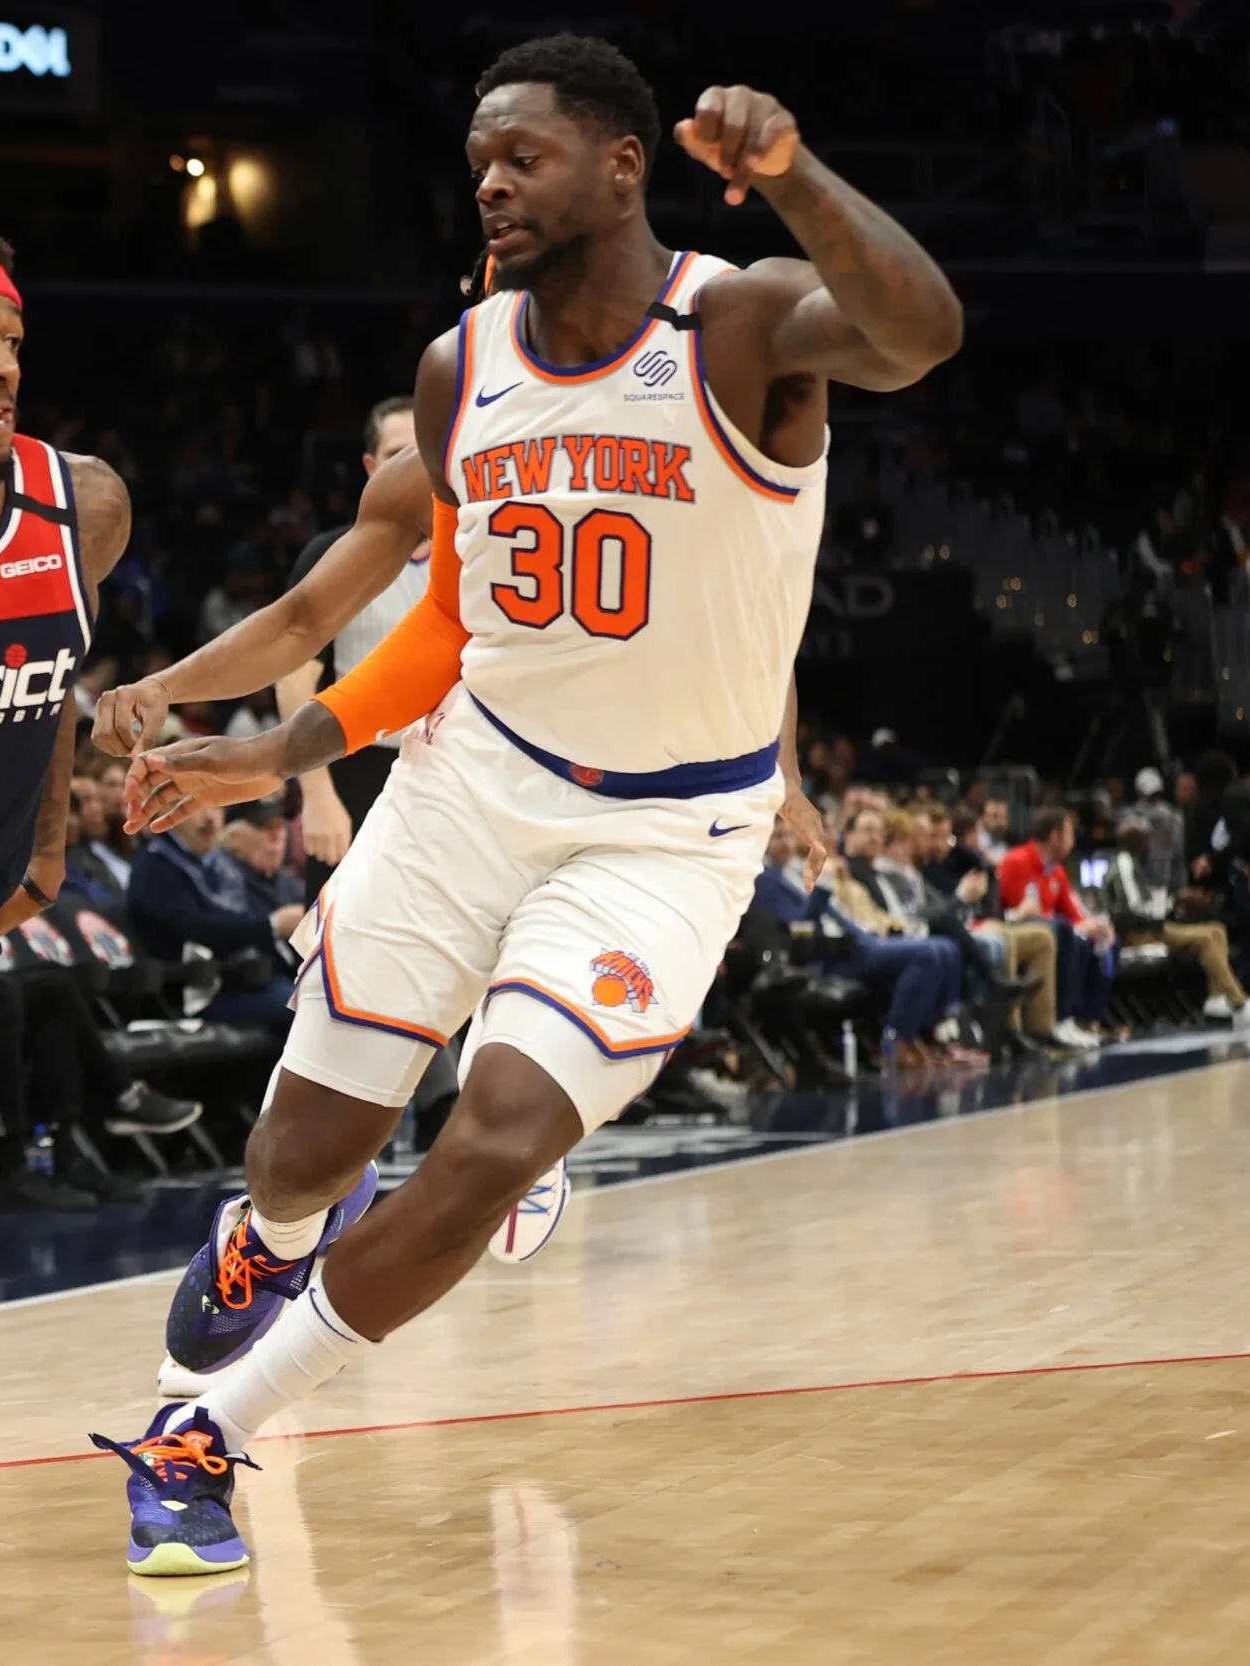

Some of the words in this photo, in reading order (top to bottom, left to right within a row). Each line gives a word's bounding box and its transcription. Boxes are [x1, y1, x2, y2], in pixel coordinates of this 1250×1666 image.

[461, 436, 557, 503] NEW
[562, 434, 696, 504] YORK
[0, 554, 62, 579] GEICO
[488, 500, 652, 641] 30
